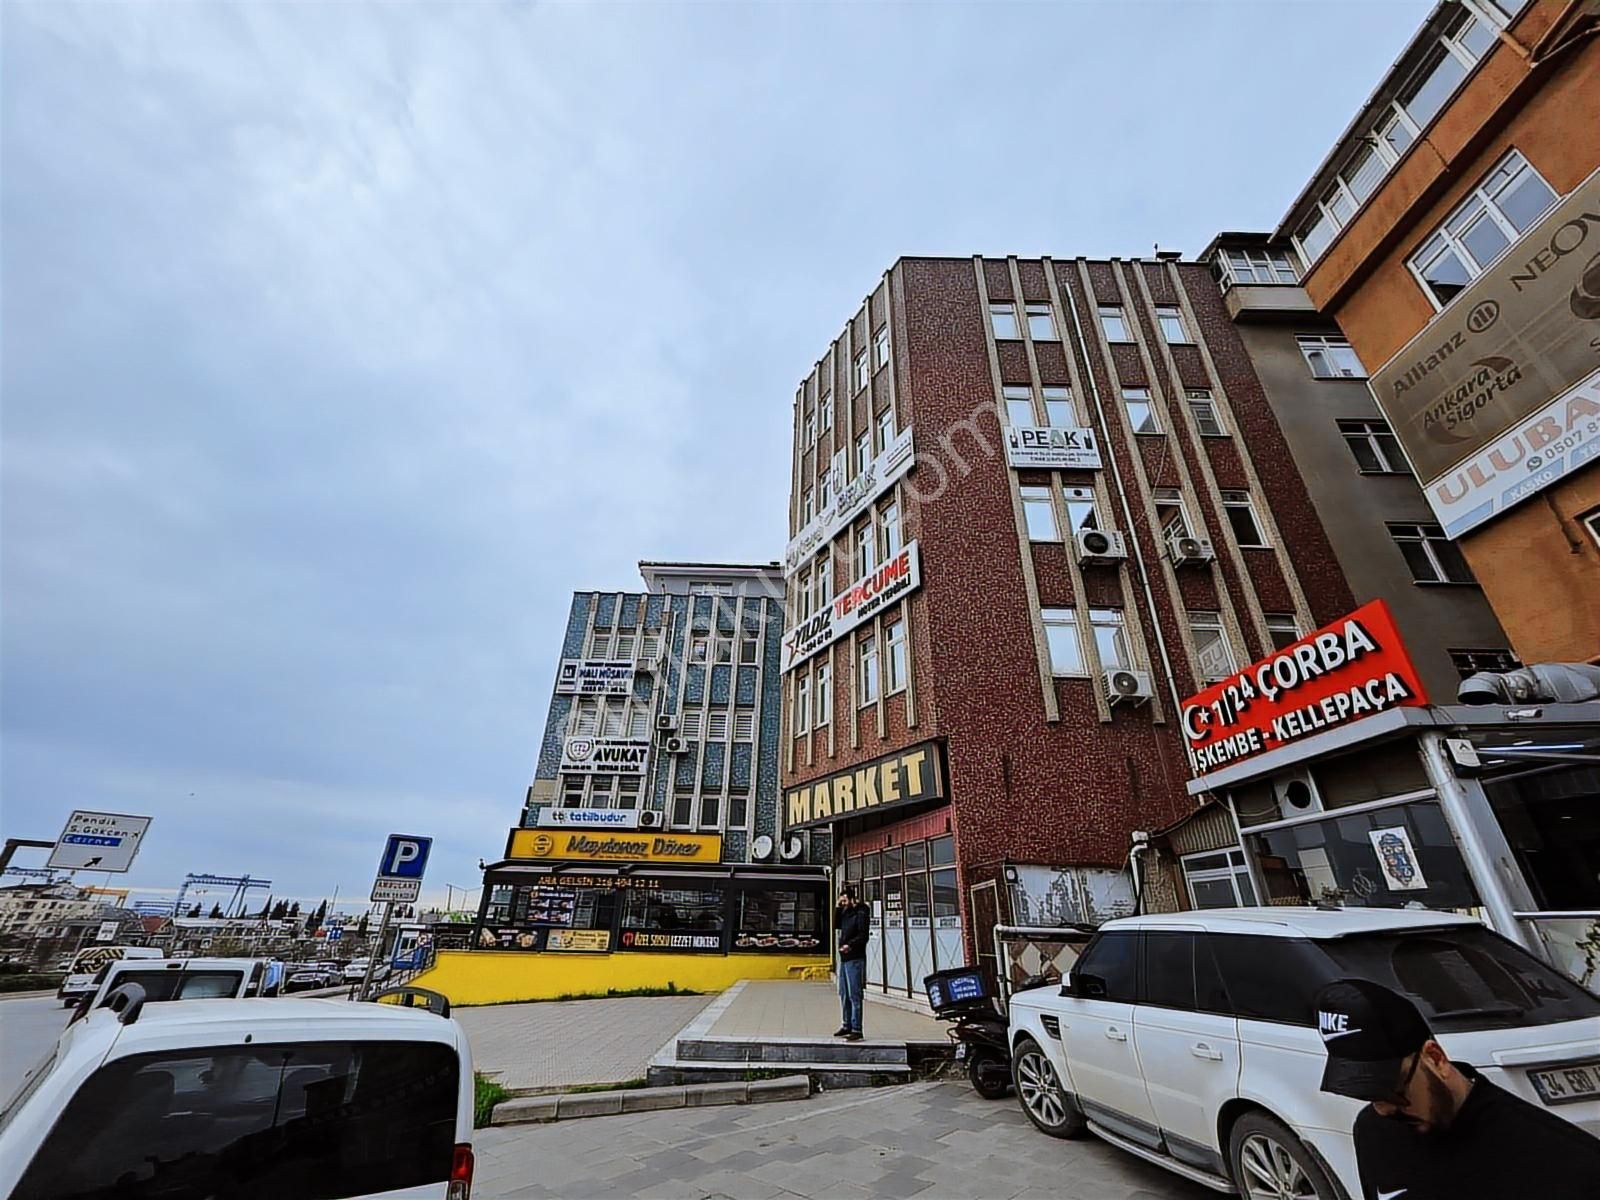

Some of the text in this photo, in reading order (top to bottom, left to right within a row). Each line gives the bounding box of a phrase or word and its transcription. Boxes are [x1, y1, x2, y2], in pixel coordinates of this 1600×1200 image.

[1509, 213, 1600, 292] NEO
[1393, 332, 1466, 398] Allianz
[1424, 368, 1491, 429] Ankara
[1445, 366, 1522, 431] Sigorta
[1021, 428, 1080, 446] PEAK
[1436, 382, 1600, 505] ULUBA
[1545, 430, 1583, 459] 0507
[1257, 620, 1376, 702] ÇORBA
[1190, 727, 1261, 773] İŞKEMBE
[1273, 672, 1408, 742] KELLEPAÇA
[592, 747, 648, 763] AVUKAT
[570, 811, 626, 823] tatilbudur
[787, 750, 926, 827] MARKET
[74, 814, 117, 826] Pendik
[652, 837, 703, 857] Döner
[390, 840, 420, 873] P
